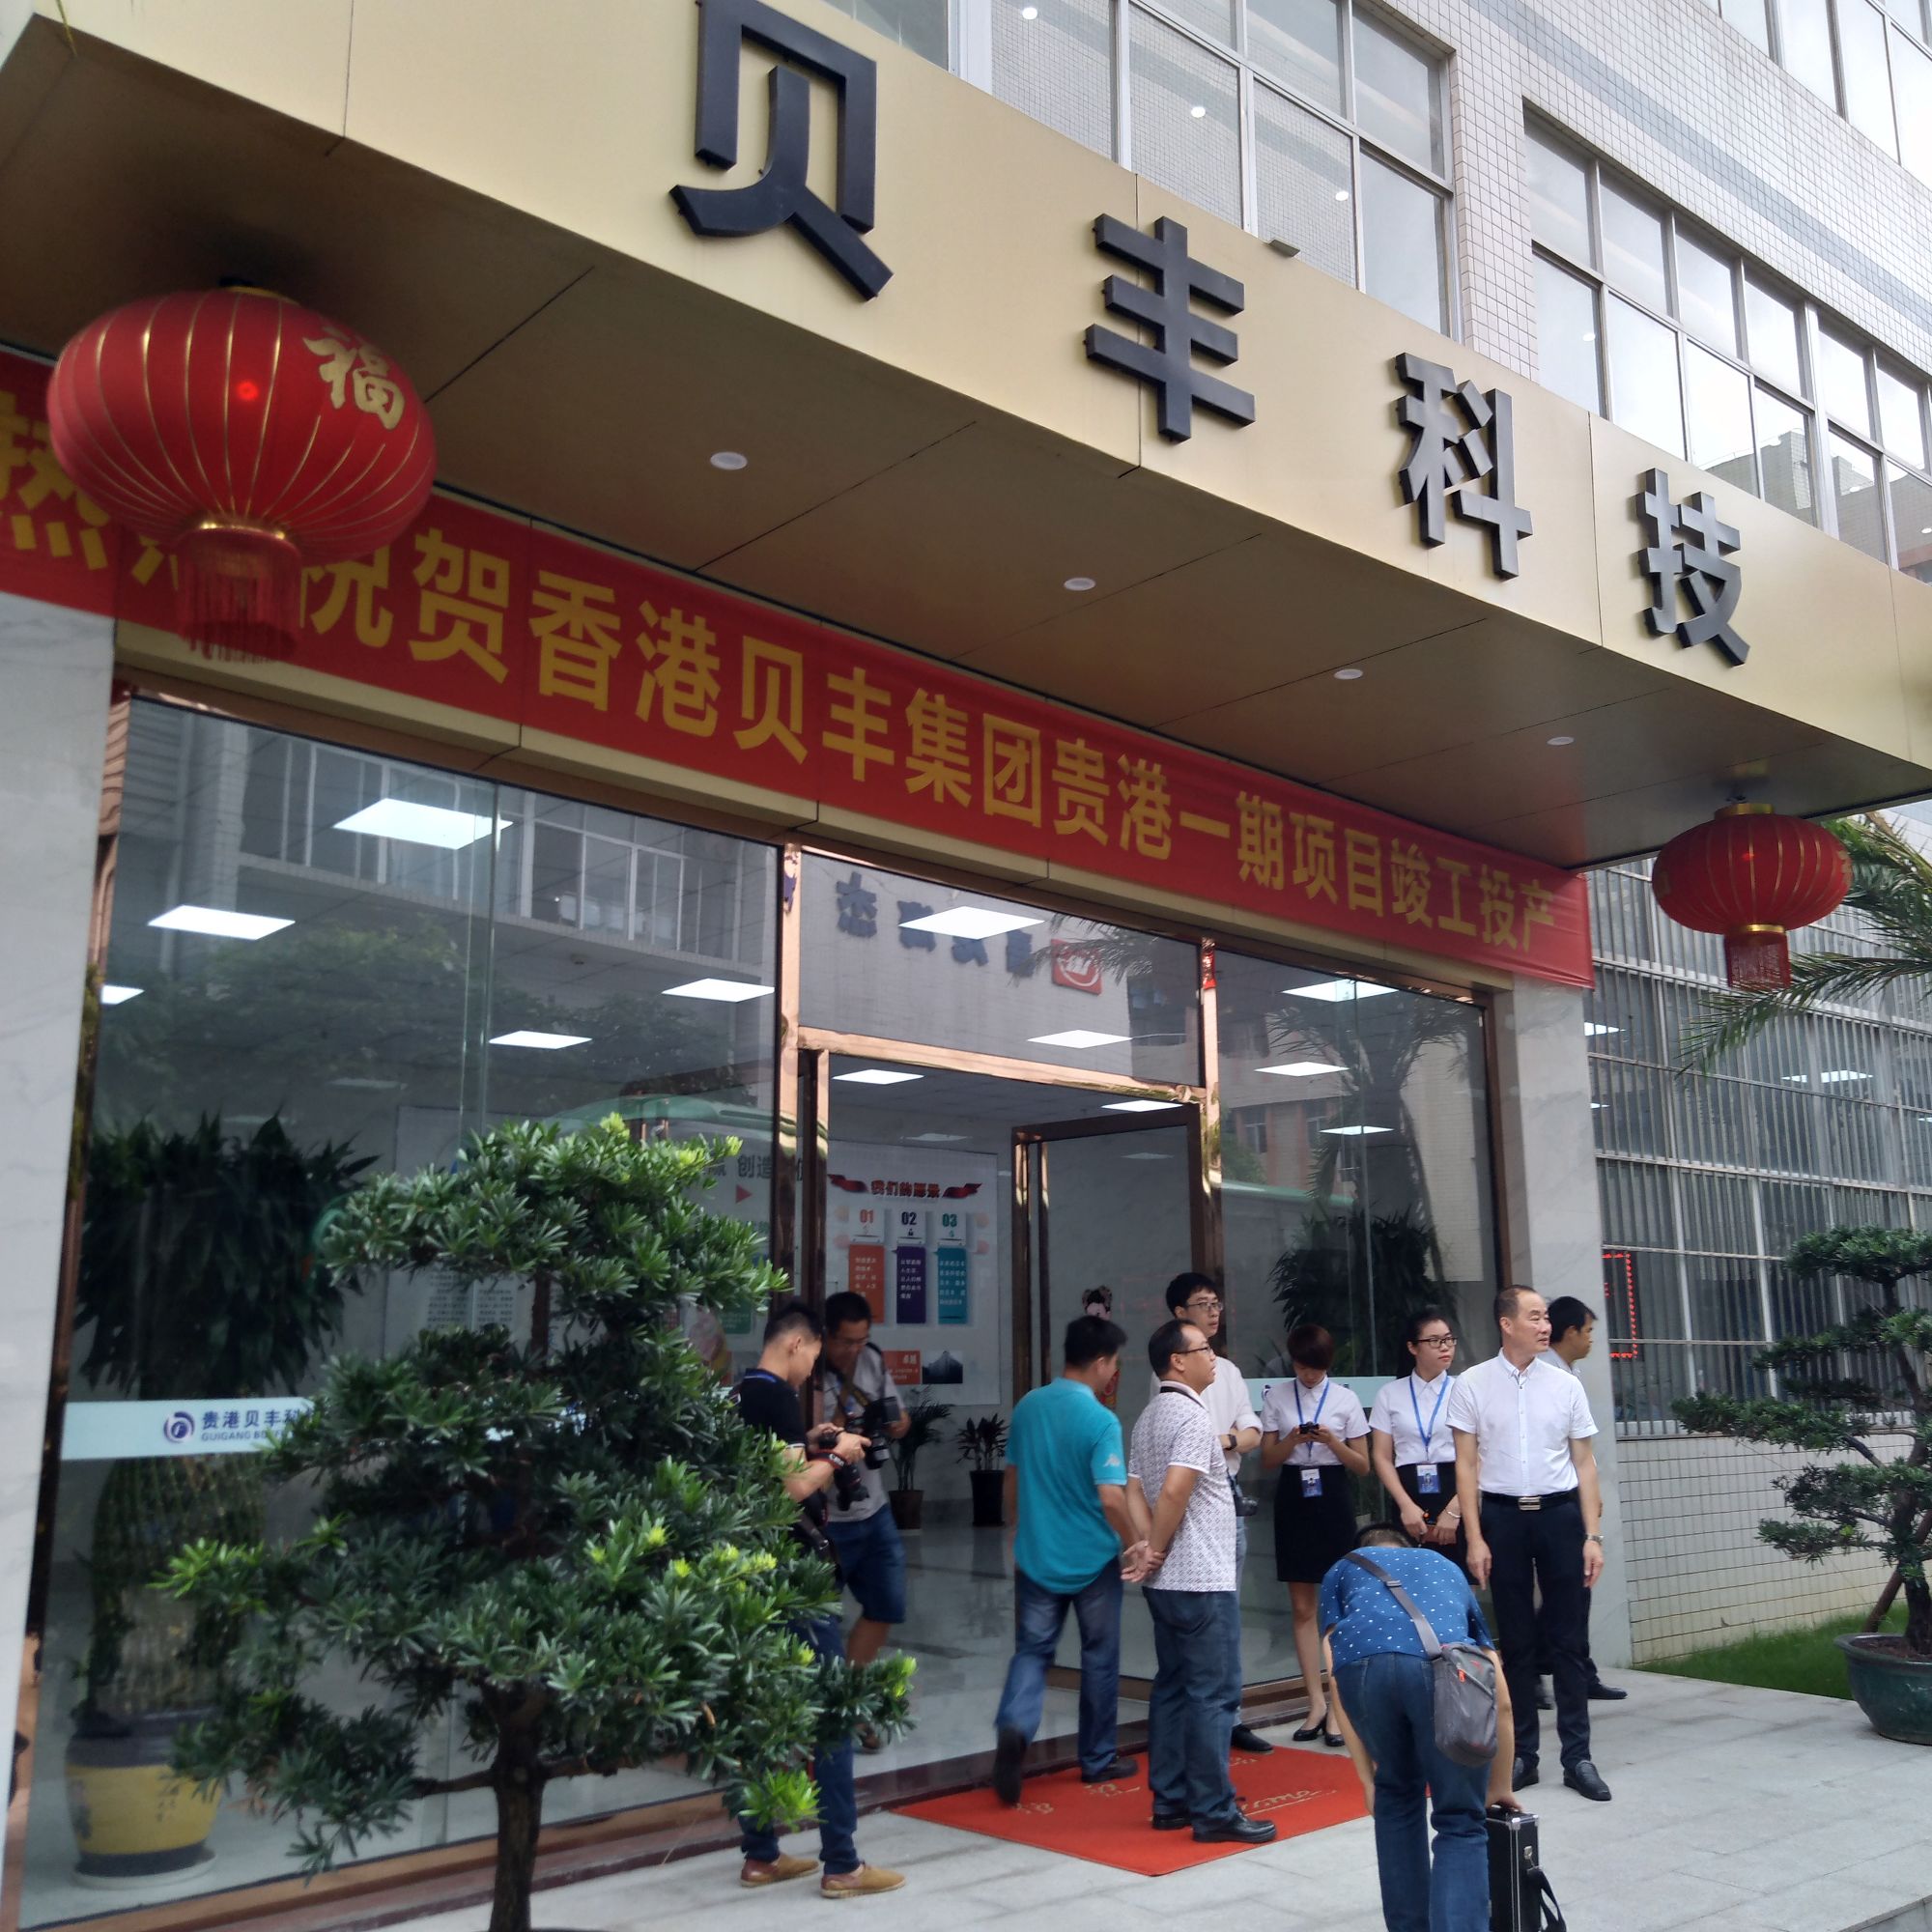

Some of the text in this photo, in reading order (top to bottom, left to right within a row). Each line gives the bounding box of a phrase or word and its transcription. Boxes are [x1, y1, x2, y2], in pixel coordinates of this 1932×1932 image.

[669, 0, 1749, 667] 贝丰科技
[302, 327, 405, 430] 福
[860, 1209, 874, 1224] 01
[901, 1211, 917, 1226] 02
[942, 1213, 957, 1228] 03
[201, 1431, 251, 1441] GUIGANG
